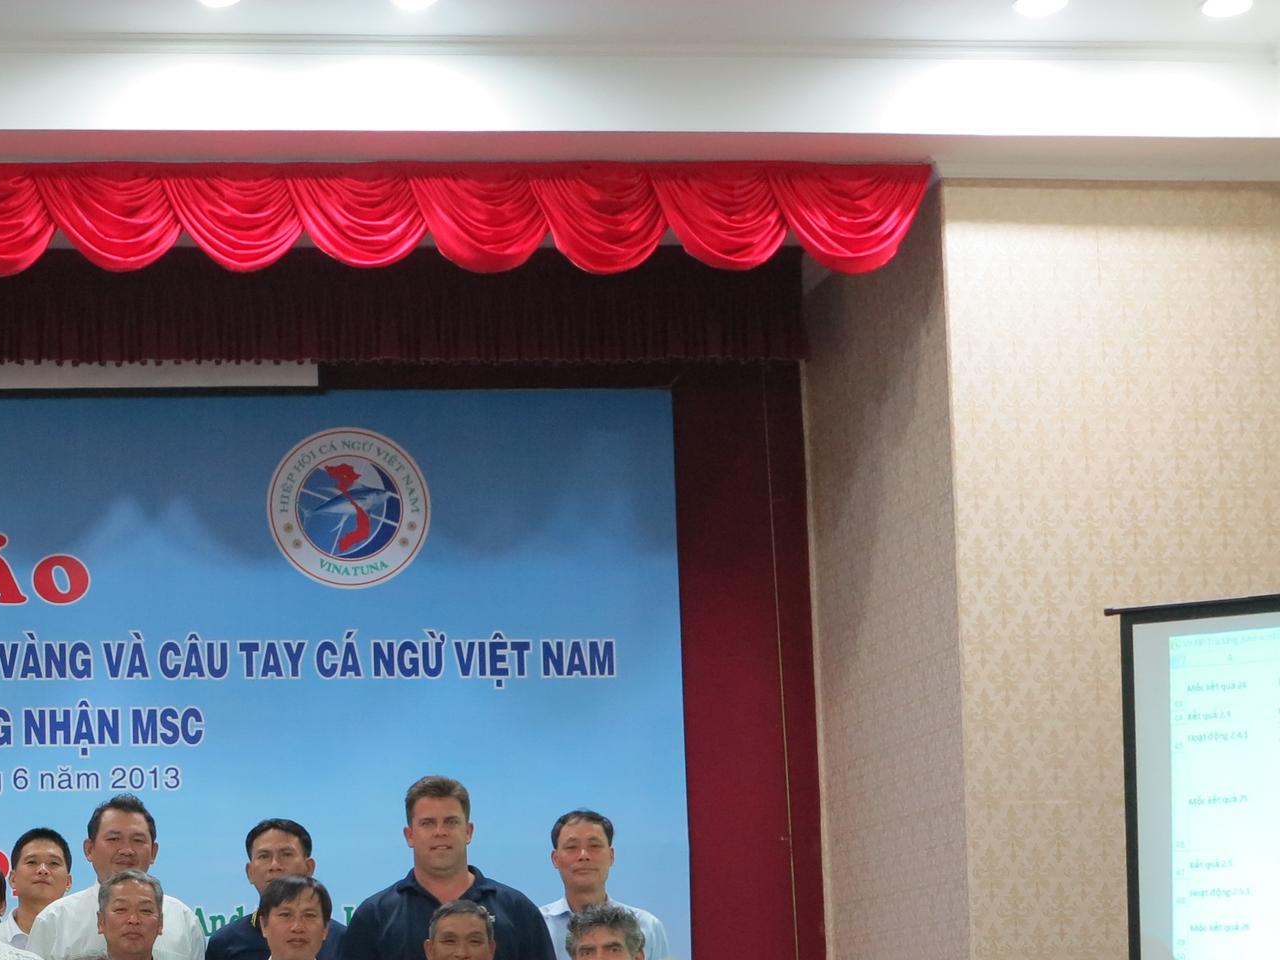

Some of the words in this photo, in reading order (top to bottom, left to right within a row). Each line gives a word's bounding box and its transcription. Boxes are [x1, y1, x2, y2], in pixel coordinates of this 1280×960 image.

[320, 440, 338, 456] CÁ
[402, 474, 420, 513] NAM
[320, 559, 389, 577] VINATUNA
[103, 631, 150, 679] VÀ
[159, 633, 228, 679] CÂU
[238, 641, 306, 678] TAY
[316, 631, 362, 678] CÁ
[373, 631, 446, 678] NGỪ
[454, 631, 531, 688] VIỆT
[542, 640, 615, 677] NAM
[24, 700, 120, 756] NHẬN
[132, 707, 204, 745] MSC
[12, 768, 29, 790] 6
[39, 767, 100, 790] năm
[110, 767, 181, 790] 2013
